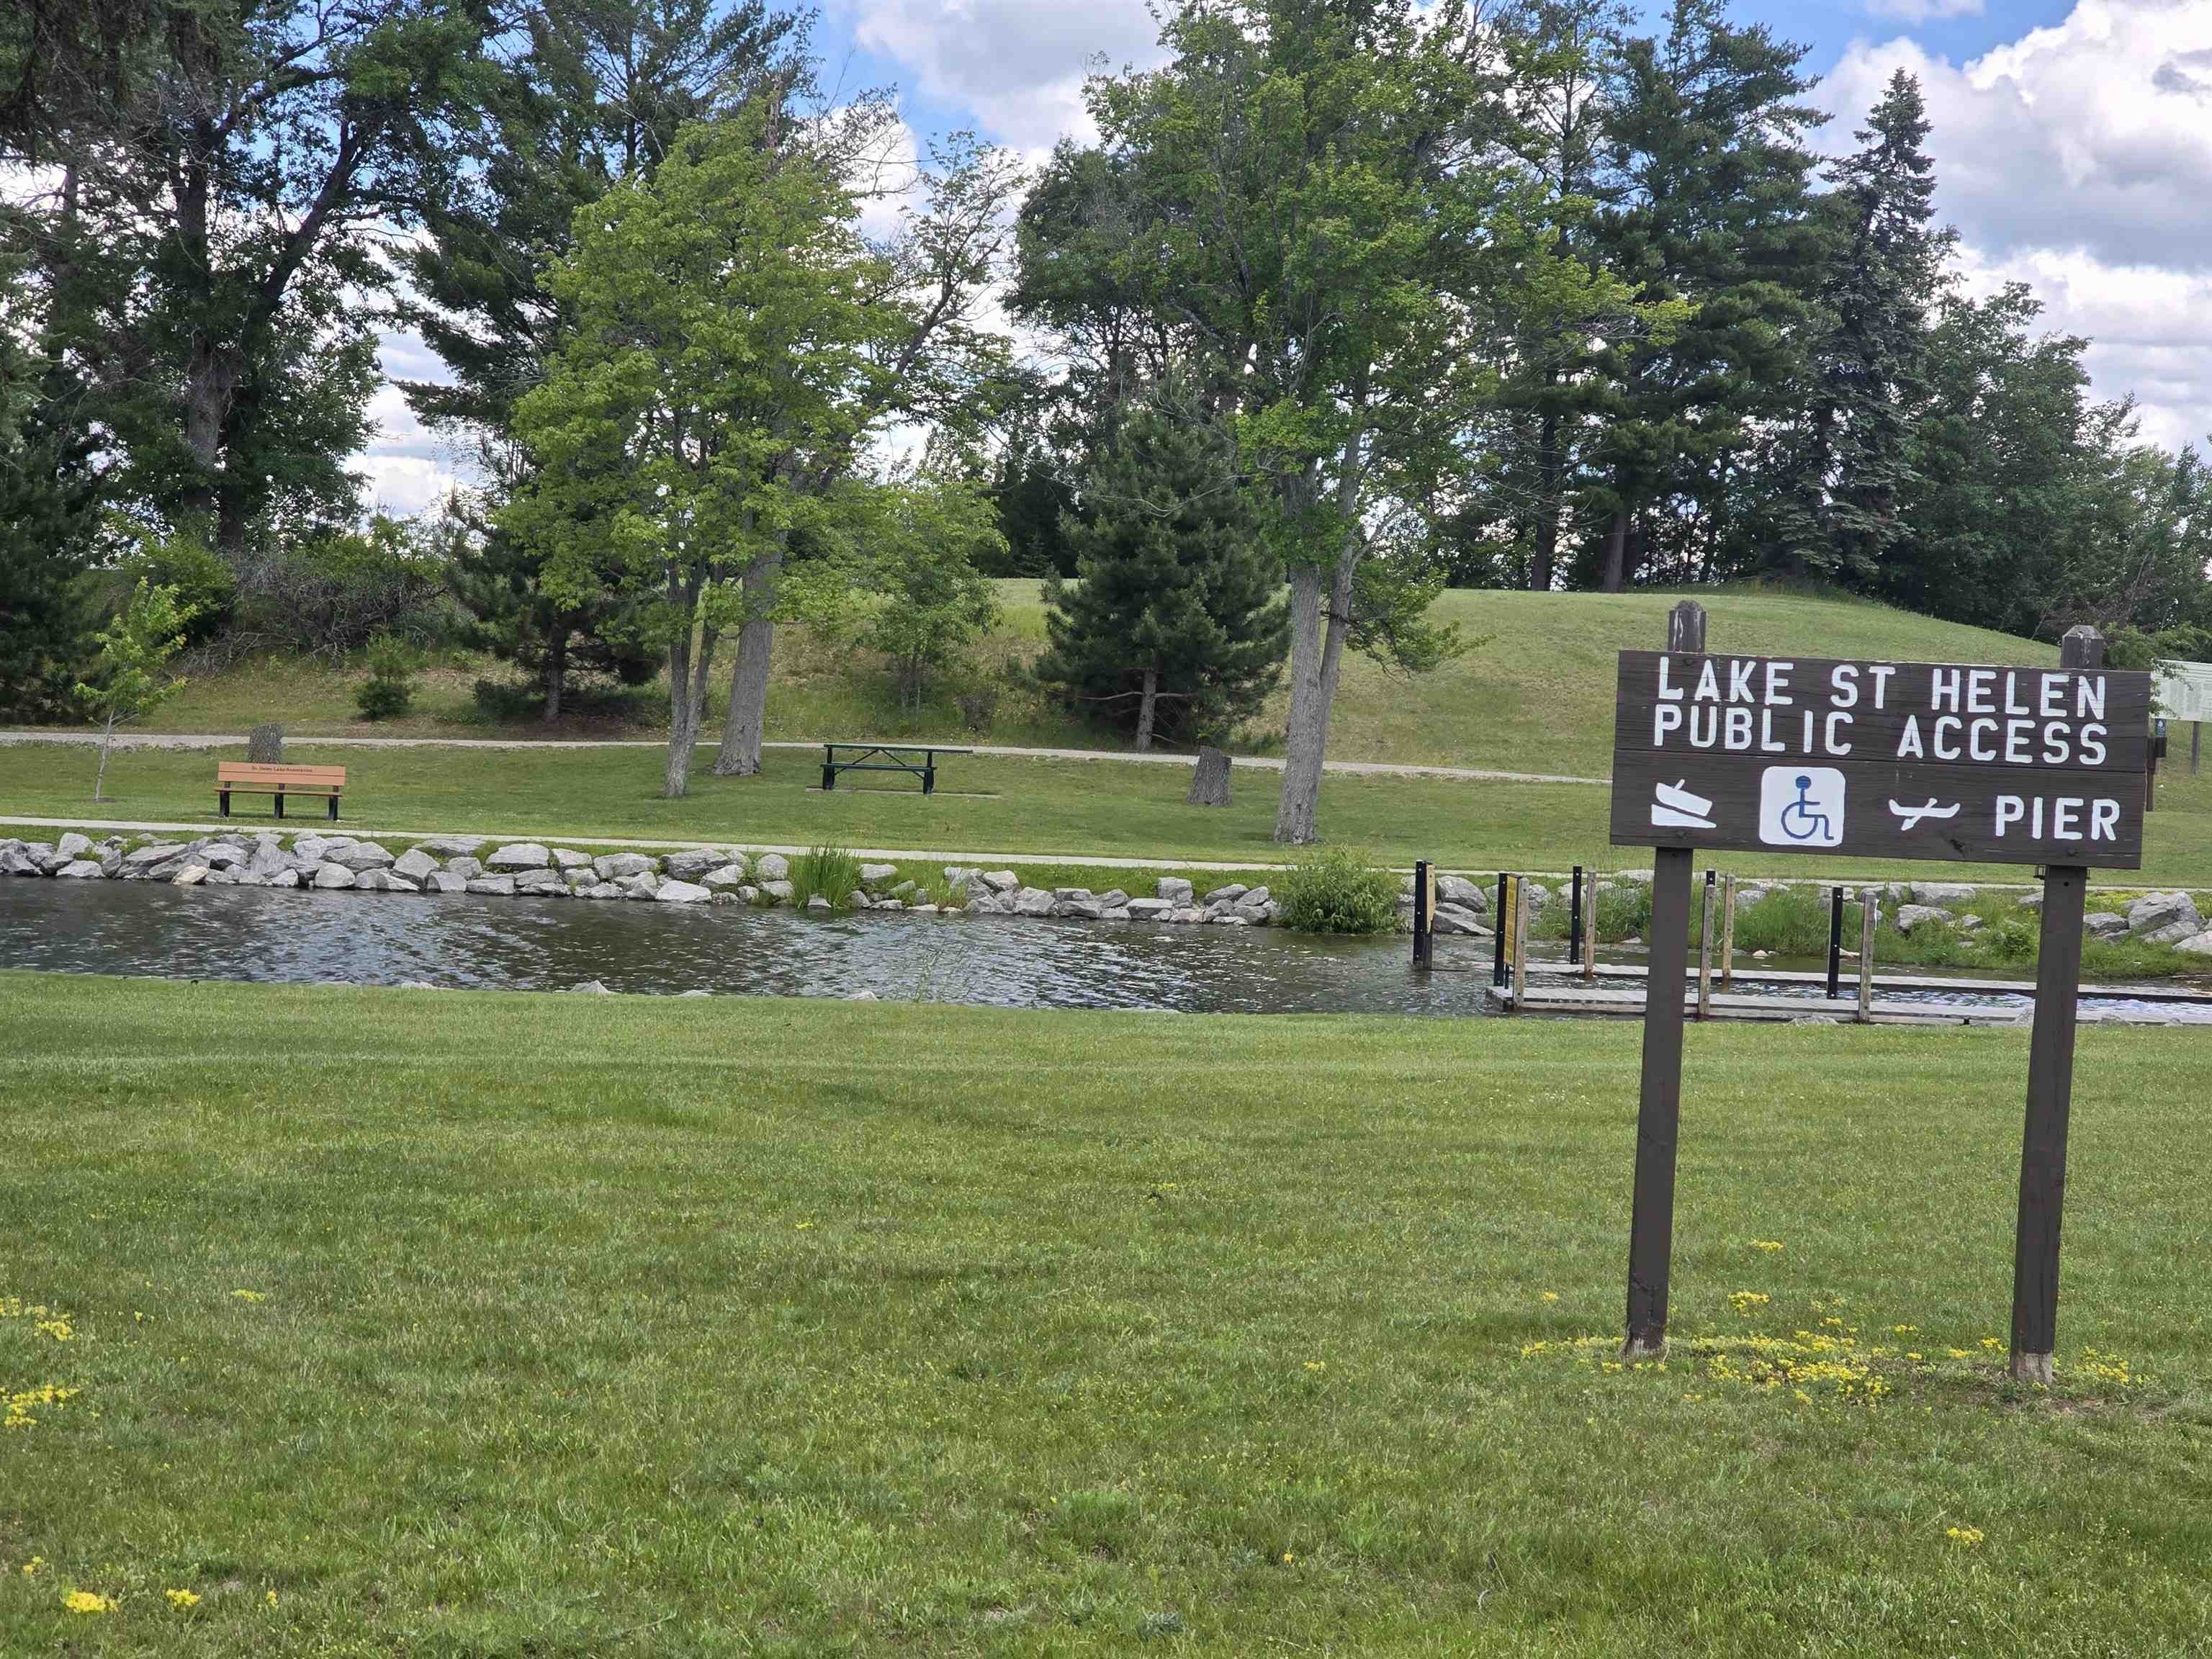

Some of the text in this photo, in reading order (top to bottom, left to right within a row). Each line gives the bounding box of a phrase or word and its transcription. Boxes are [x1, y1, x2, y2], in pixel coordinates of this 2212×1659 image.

[1658, 656, 1794, 706] LAKE
[1830, 665, 1896, 709] ST
[1931, 668, 2105, 720] HELEN
[1654, 703, 2107, 765] PUBLIC ACCESS
[1995, 795, 2120, 841] PIER
